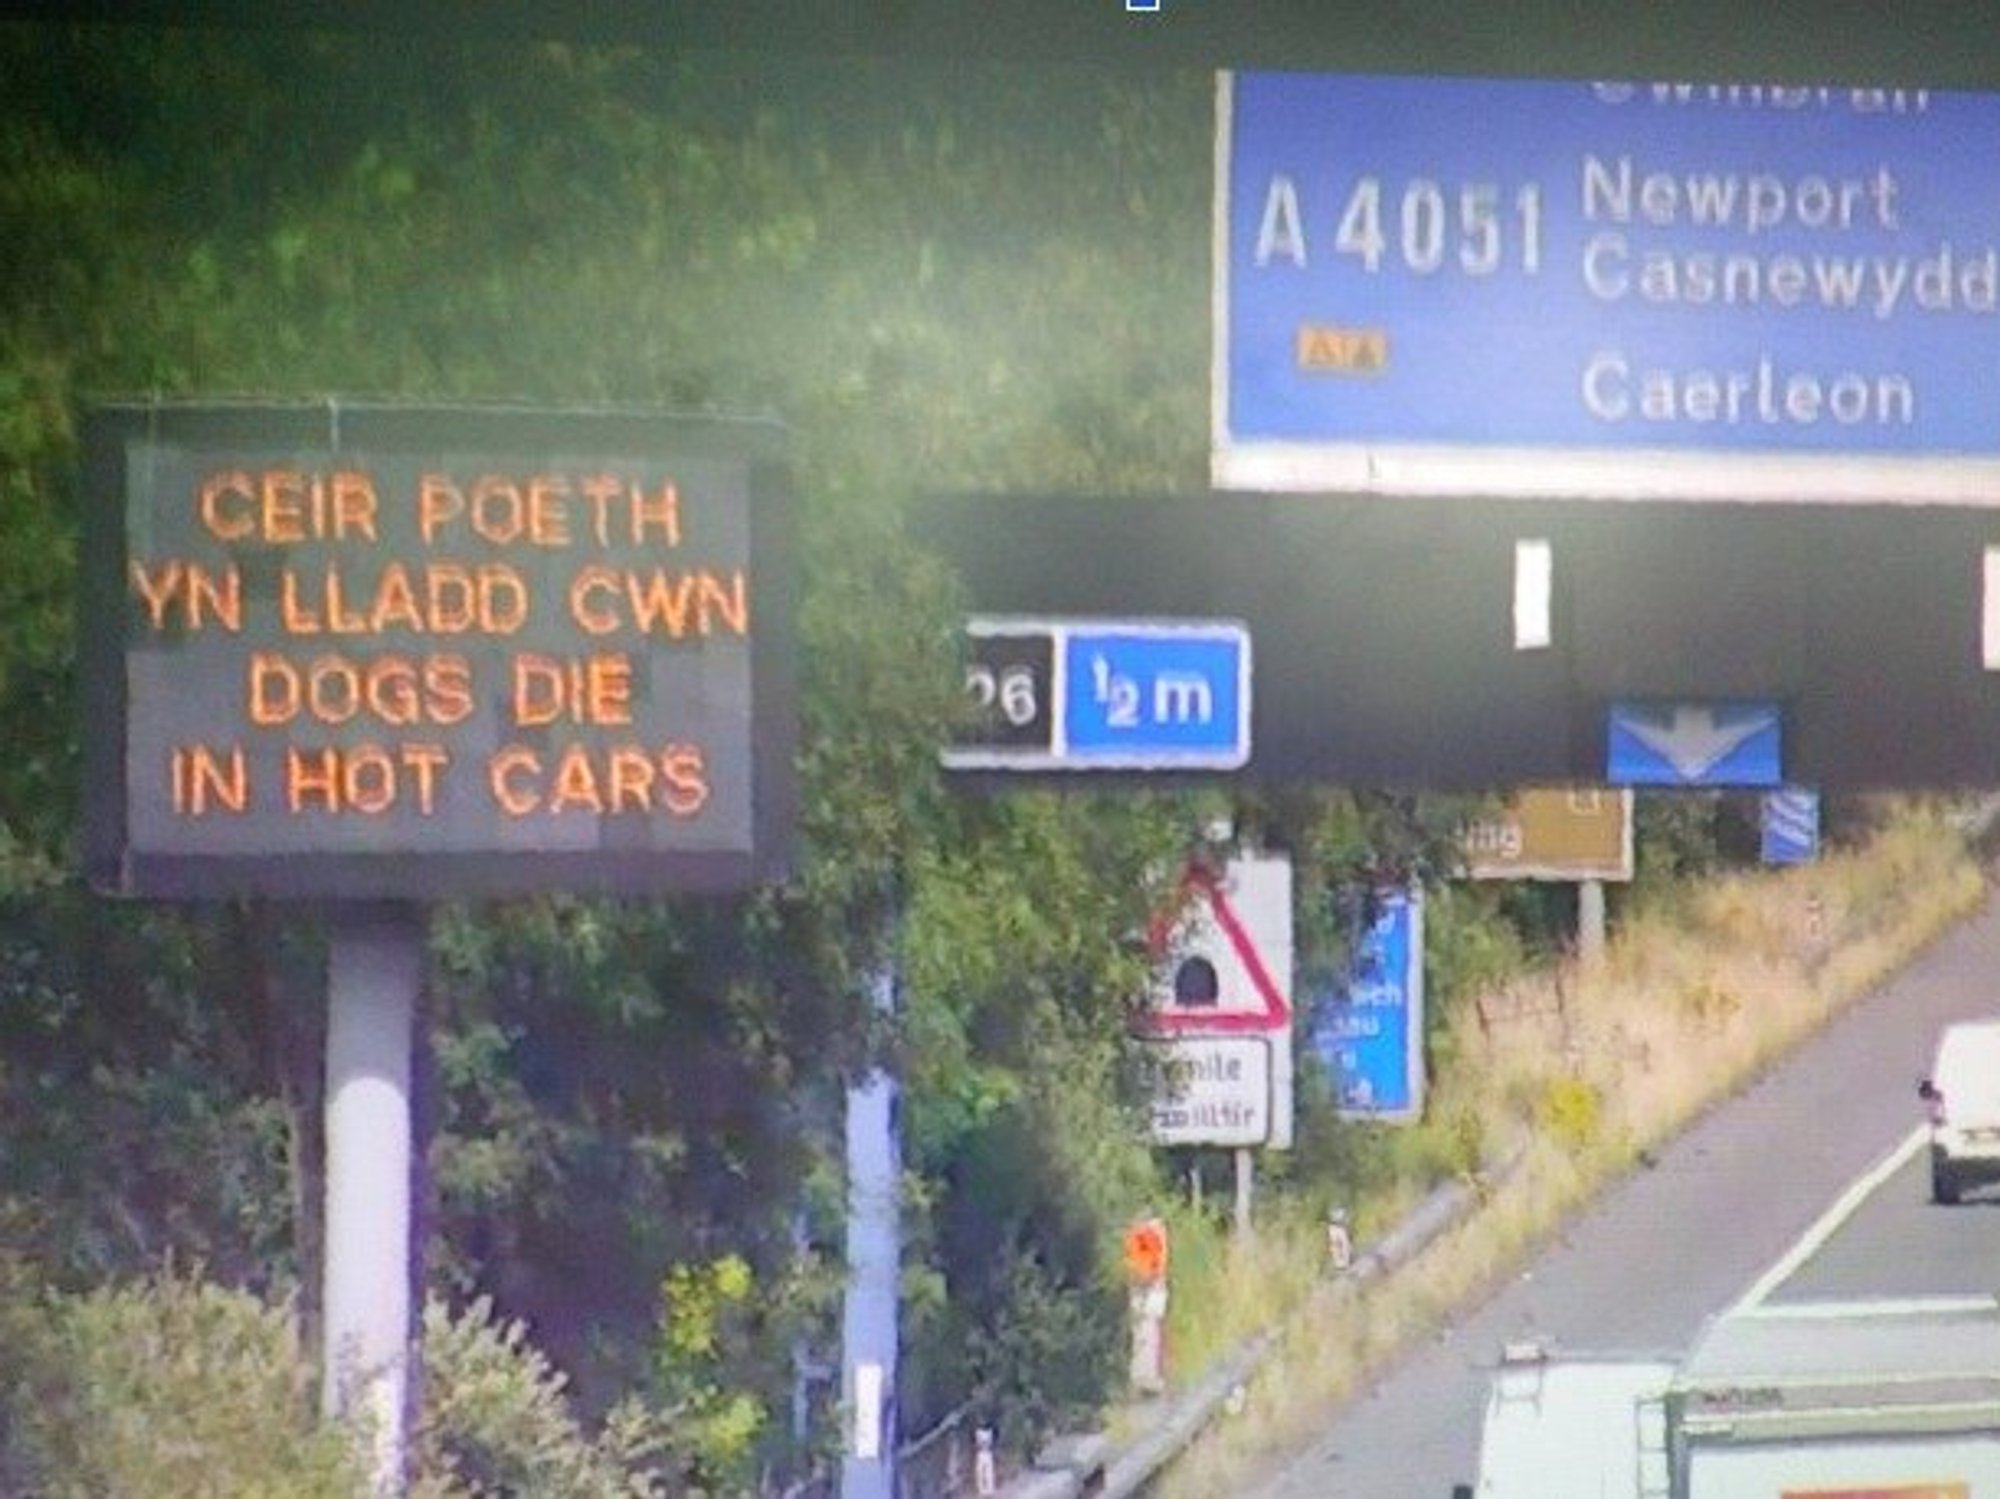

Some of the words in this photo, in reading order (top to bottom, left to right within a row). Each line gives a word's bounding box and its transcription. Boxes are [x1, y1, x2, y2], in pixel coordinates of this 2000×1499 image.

[1255, 174, 1307, 270] A
[1335, 176, 1541, 275] 4051
[1581, 153, 1899, 234] Newport
[1581, 231, 1998, 320] Casnewydd
[1581, 349, 1914, 425] Caerleon
[199, 468, 379, 542] CEIR
[417, 470, 681, 547] POETH
[128, 558, 241, 632] YN
[283, 559, 529, 634] LLADD
[570, 564, 749, 637] CWN
[249, 650, 475, 725] DOGS
[513, 650, 633, 726] DIE
[171, 743, 248, 815] IN
[286, 741, 451, 815] HOT
[489, 742, 710, 819] CARS
